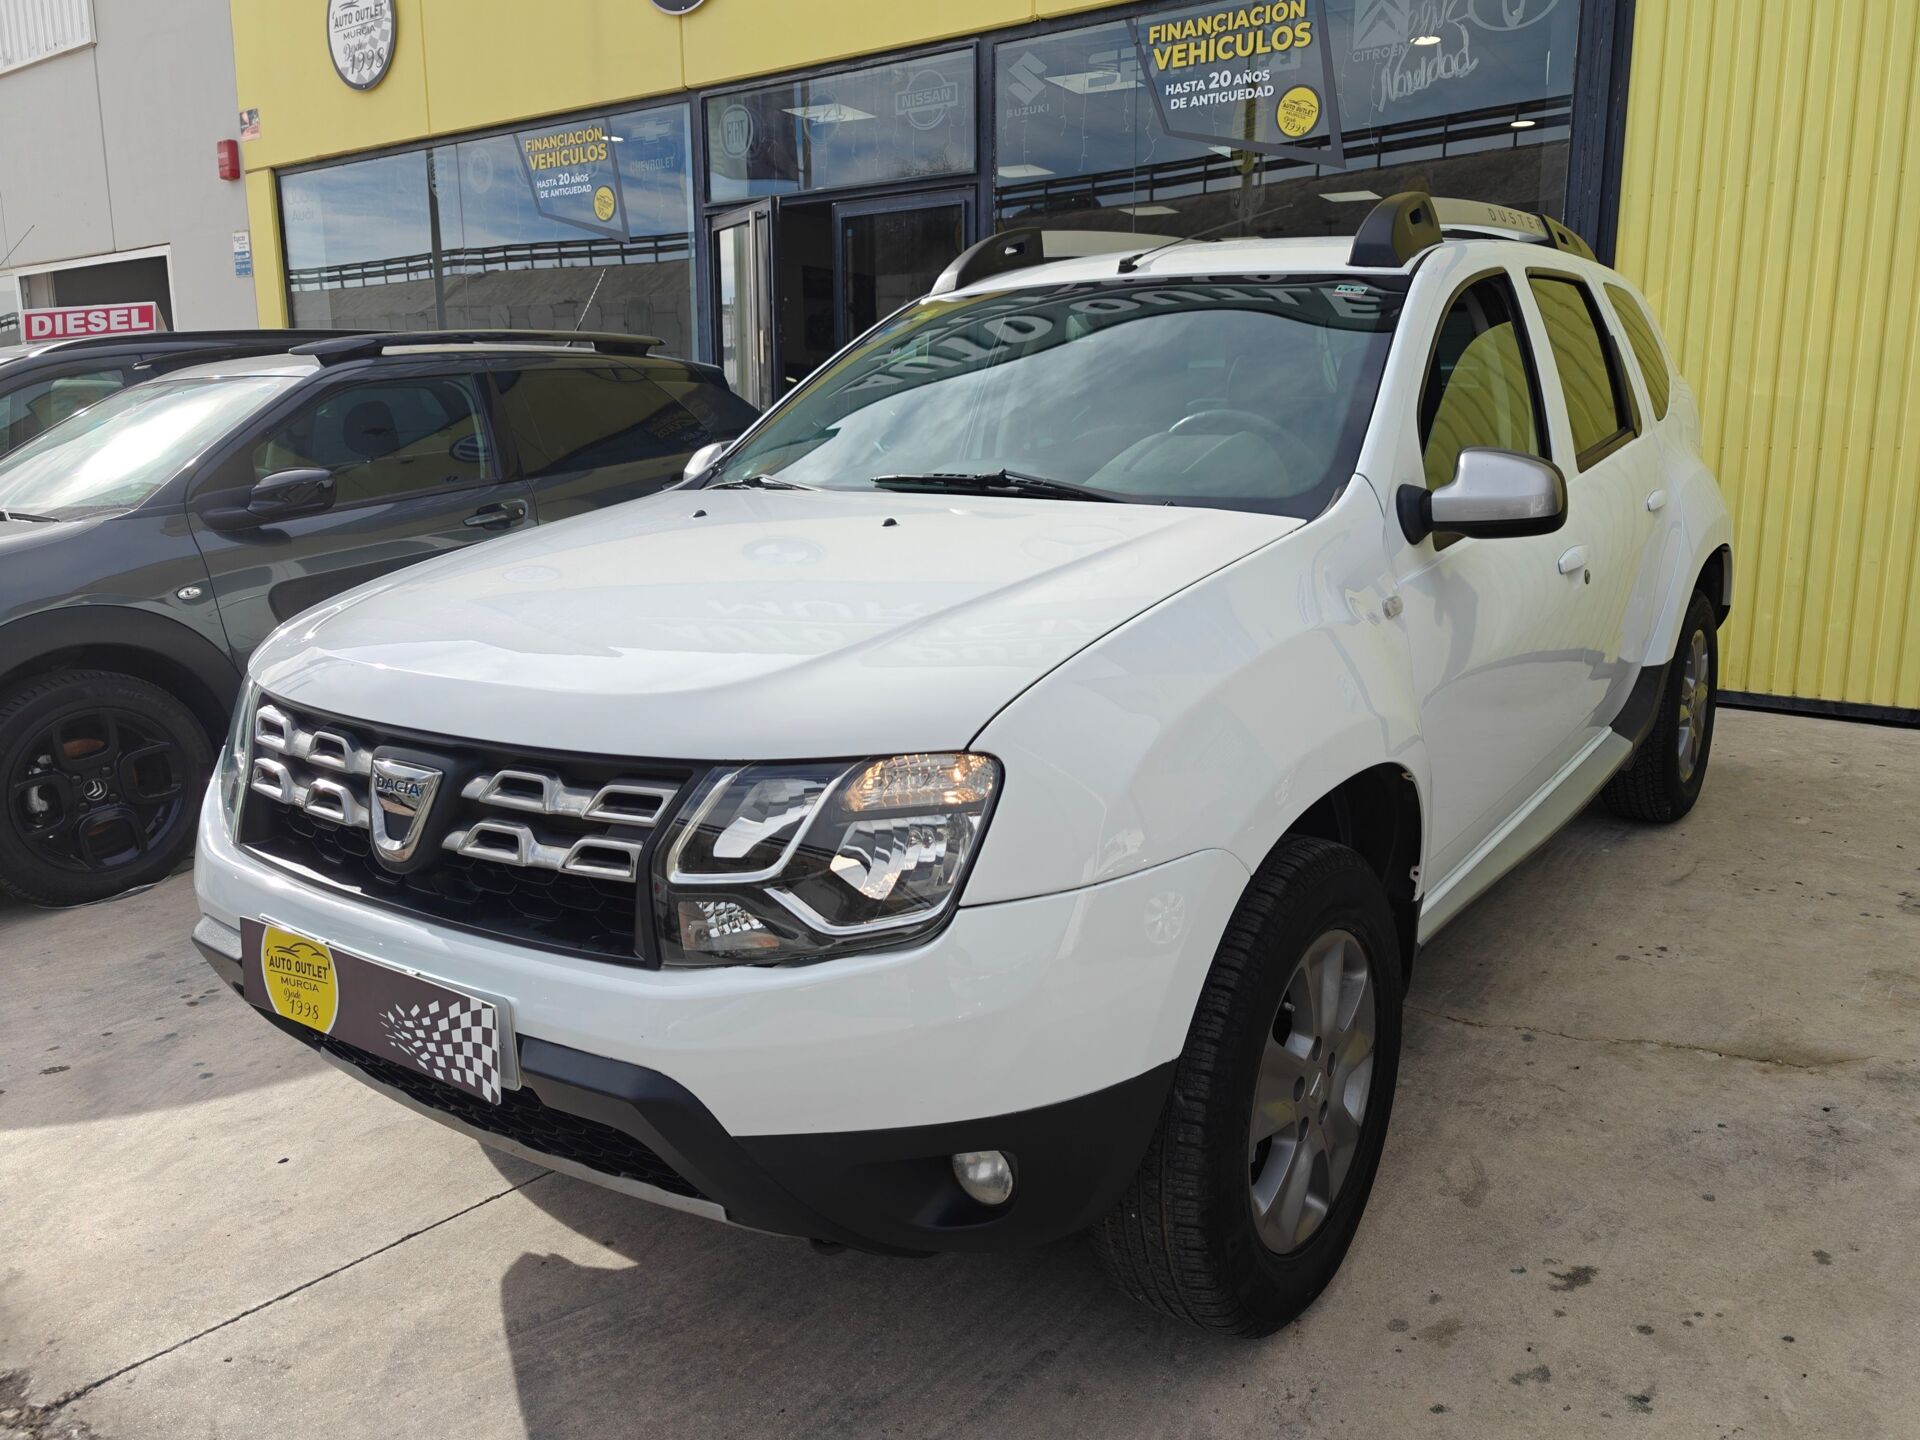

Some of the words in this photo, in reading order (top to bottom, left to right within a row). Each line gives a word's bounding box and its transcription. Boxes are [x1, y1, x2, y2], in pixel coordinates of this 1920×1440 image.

[334, 12, 353, 28] AUTO
[355, 3, 384, 22] OUTLET
[1148, 0, 1307, 45] FINANCIACIÓN
[343, 25, 376, 40] MURCIA
[1153, 22, 1312, 71] VEHÍCULOS
[350, 47, 385, 75] 1998
[1165, 80, 1206, 96] HASTA
[1208, 70, 1232, 89] 20
[1233, 69, 1270, 85] AÑOS
[901, 87, 951, 107] NISSAN
[1170, 98, 1188, 110] DE
[1190, 85, 1275, 108] ANTIGUEDAD
[1006, 104, 1050, 118] SUZUKI
[525, 126, 604, 153] FINANCIACIÓN
[727, 119, 745, 145] FIAT
[528, 143, 608, 171] VEHÍCULOS
[631, 156, 675, 171] CHEVROLET
[536, 177, 557, 189] HASTA
[558, 173, 570, 186] 20
[570, 172, 589, 184] AÑOS
[540, 189, 549, 198] DE
[550, 185, 592, 198] ANTIGUEDAD
[1487, 207, 1544, 232] DUSTER
[31, 308, 150, 337] DIESEL
[376, 773, 420, 797] DACIA
[269, 955, 292, 971] AUTO
[295, 960, 328, 980] OUTLET
[280, 975, 319, 992] MURCIA
[289, 999, 319, 1020] 1998
